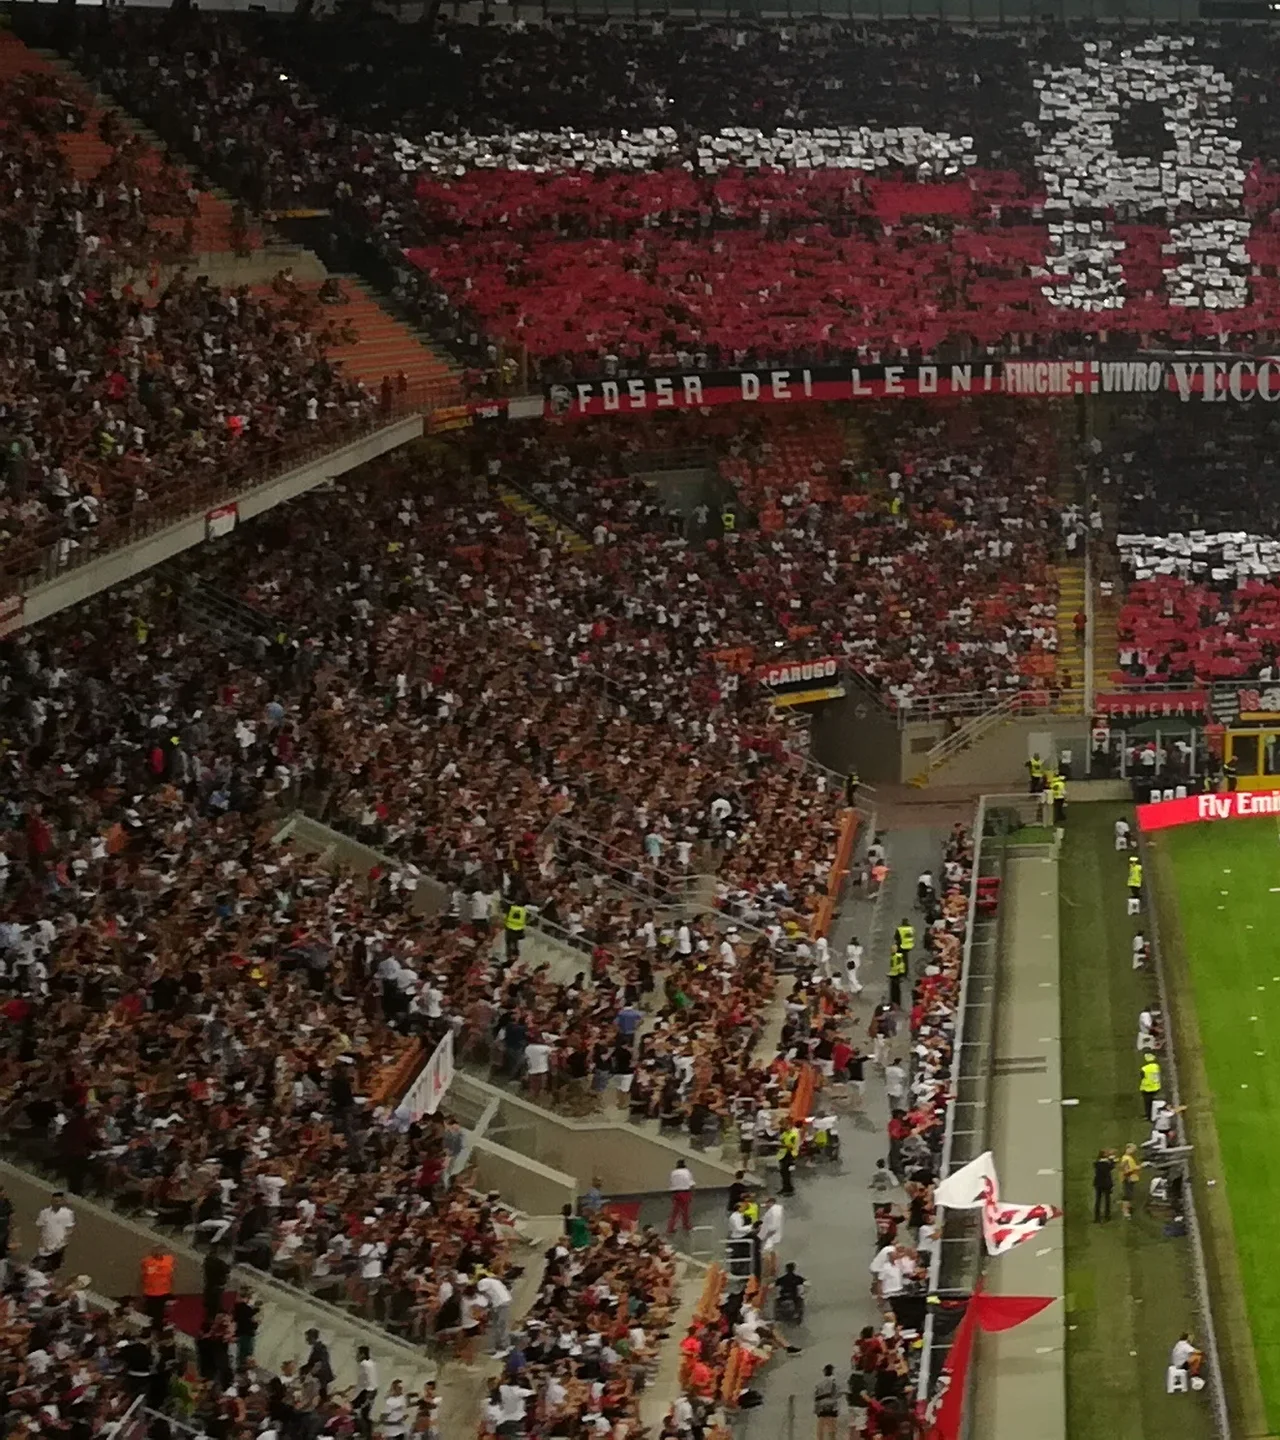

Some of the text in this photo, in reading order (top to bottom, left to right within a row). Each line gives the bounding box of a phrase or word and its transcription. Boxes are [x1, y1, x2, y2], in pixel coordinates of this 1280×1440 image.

[577, 363, 993, 413] FOSSA DEI LEONI
[769, 660, 837, 686] CARUGO
[1198, 794, 1232, 819] Fly
